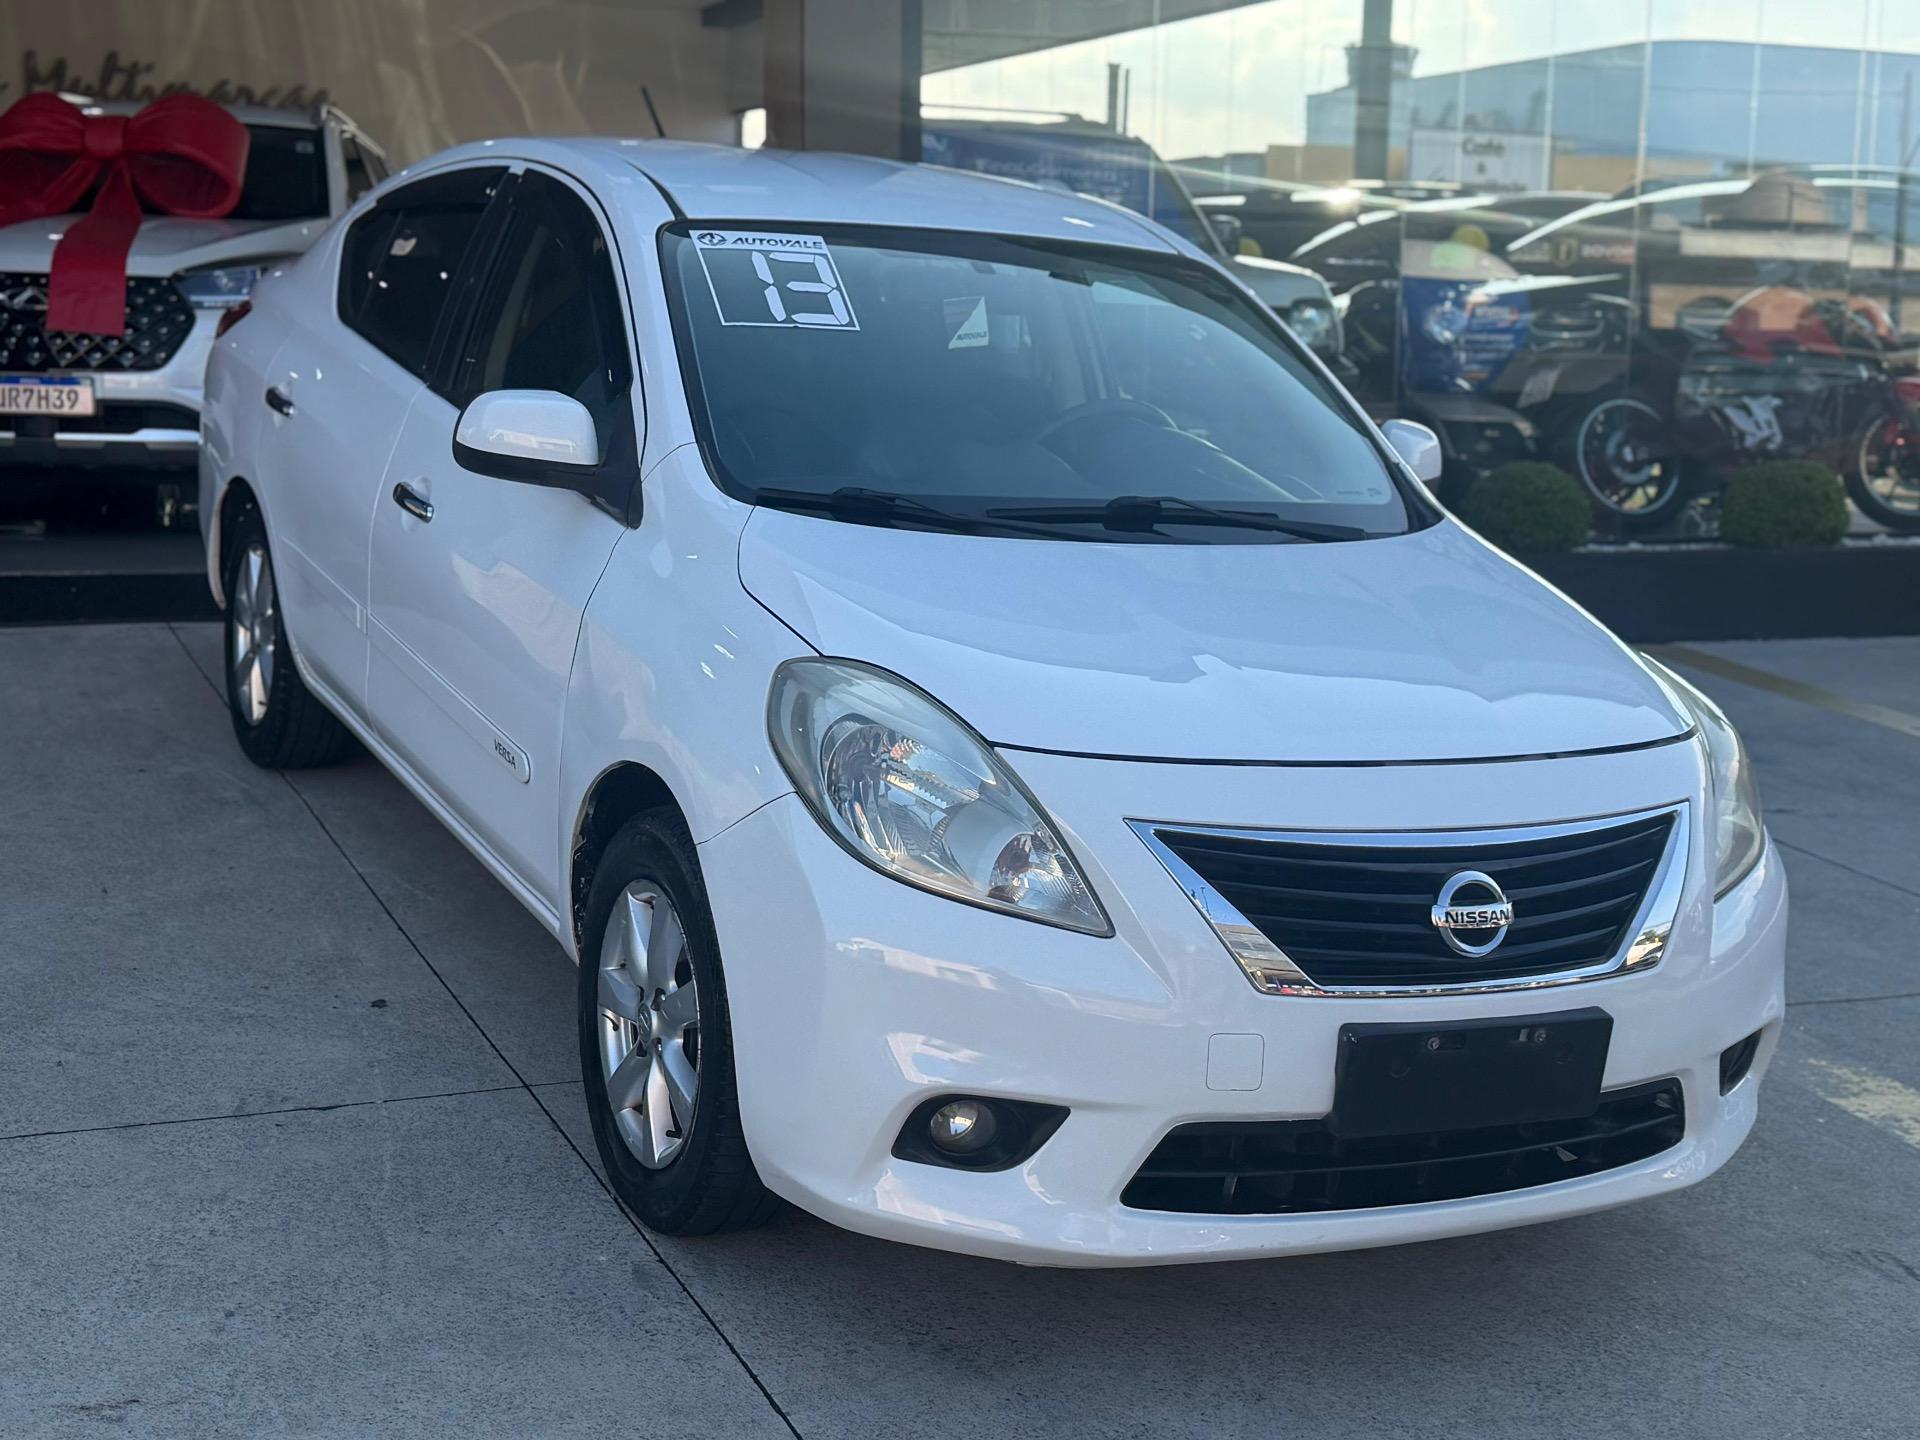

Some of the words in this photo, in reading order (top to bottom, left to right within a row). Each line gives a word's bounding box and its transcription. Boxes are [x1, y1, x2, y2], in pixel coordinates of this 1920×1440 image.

[731, 237, 823, 250] AUTOVALE
[751, 250, 850, 326] 13
[494, 739, 516, 769] VERSA
[1445, 909, 1510, 924] NISSAN
